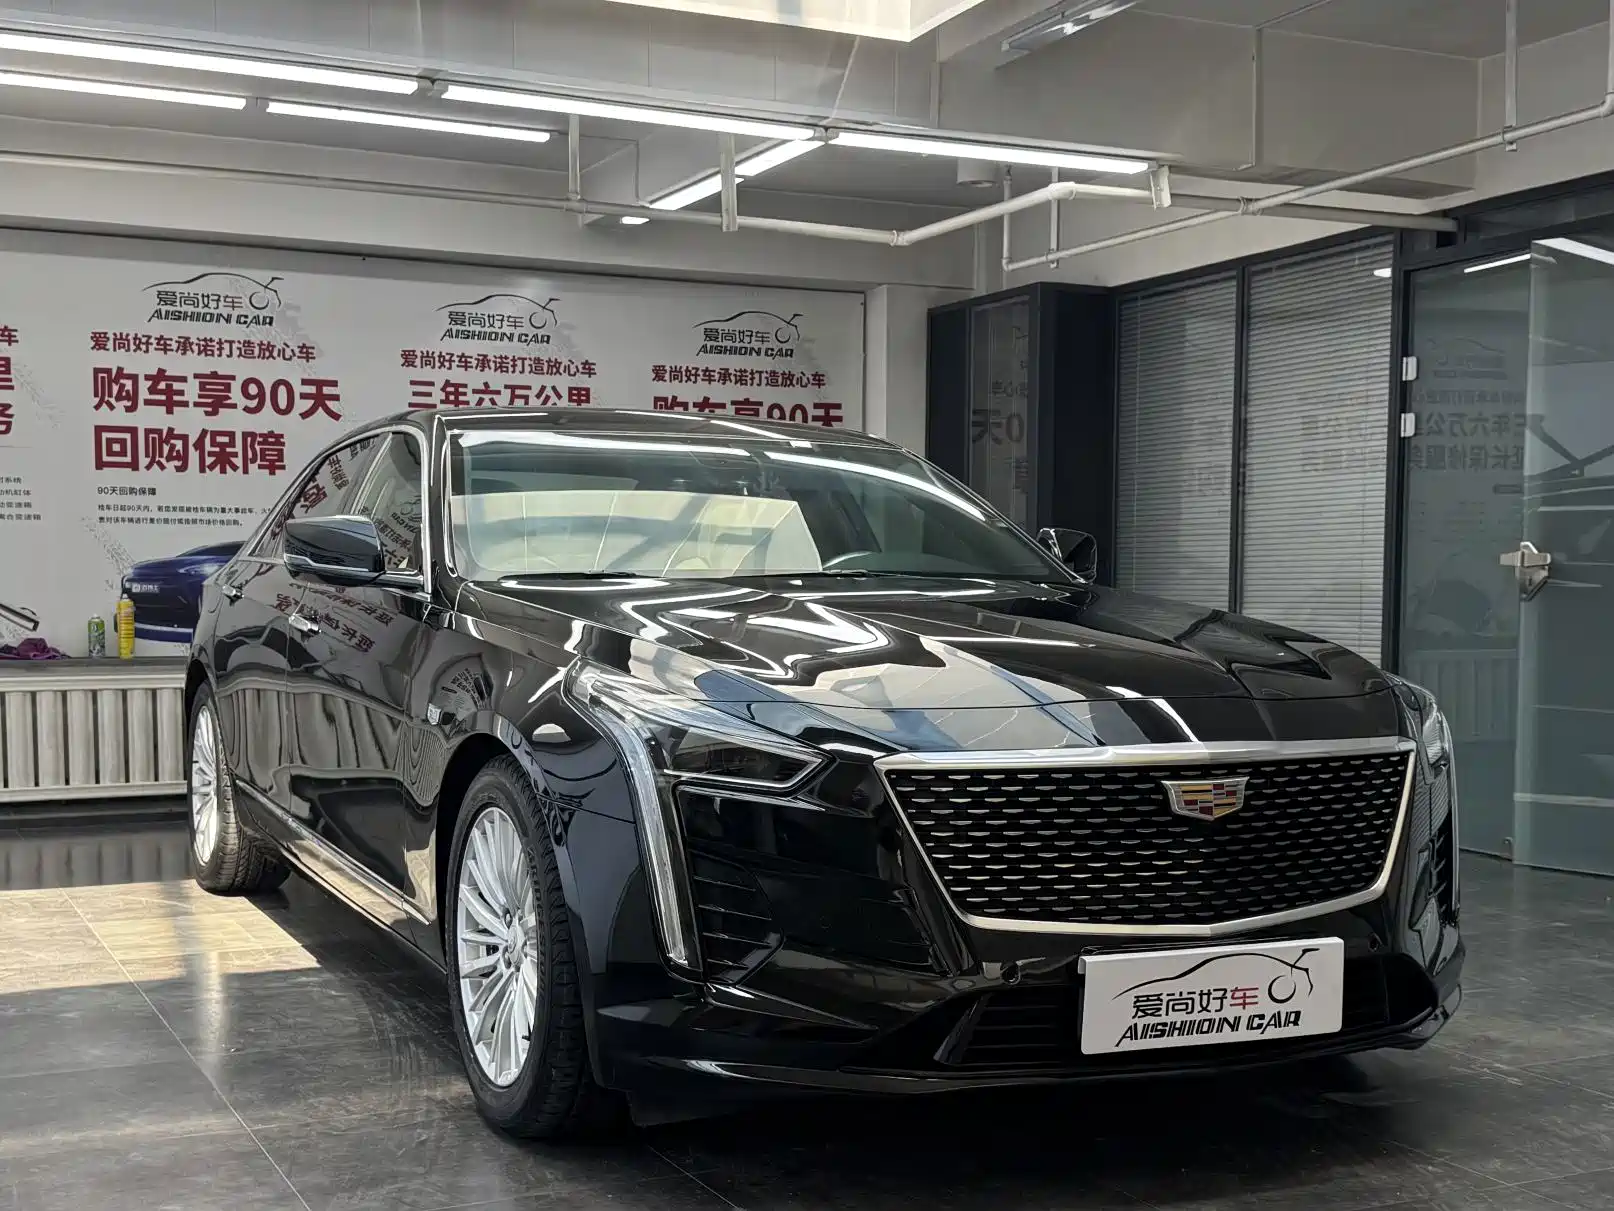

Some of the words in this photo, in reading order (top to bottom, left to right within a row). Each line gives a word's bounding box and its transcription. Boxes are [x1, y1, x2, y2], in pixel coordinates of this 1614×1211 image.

[156, 290, 244, 311] 爱尚好车
[147, 308, 232, 325] AISHION
[235, 314, 274, 328] CAR
[448, 311, 524, 329] 爱尚好车
[90, 331, 316, 363] 爱尚好车承诺打造放心车
[440, 328, 514, 342] AISHION
[518, 333, 551, 347] CAR
[703, 327, 771, 345] 爱尚好车
[400, 349, 597, 378] 爱尚好车承诺打造放心车
[696, 343, 762, 357] AISHION
[764, 347, 794, 360] CAR
[651, 364, 826, 389] 爱尚好车承诺打造放心车
[93, 366, 342, 421] 购车享90天
[408, 379, 591, 409] 三年六万公里
[94, 424, 286, 476] 回购保障
[97, 486, 157, 497] 90天回购保障
[1132, 986, 1259, 1019] 爱尚好车
[1115, 1015, 1241, 1047] AISHION
[1246, 1010, 1302, 1034] CAR
